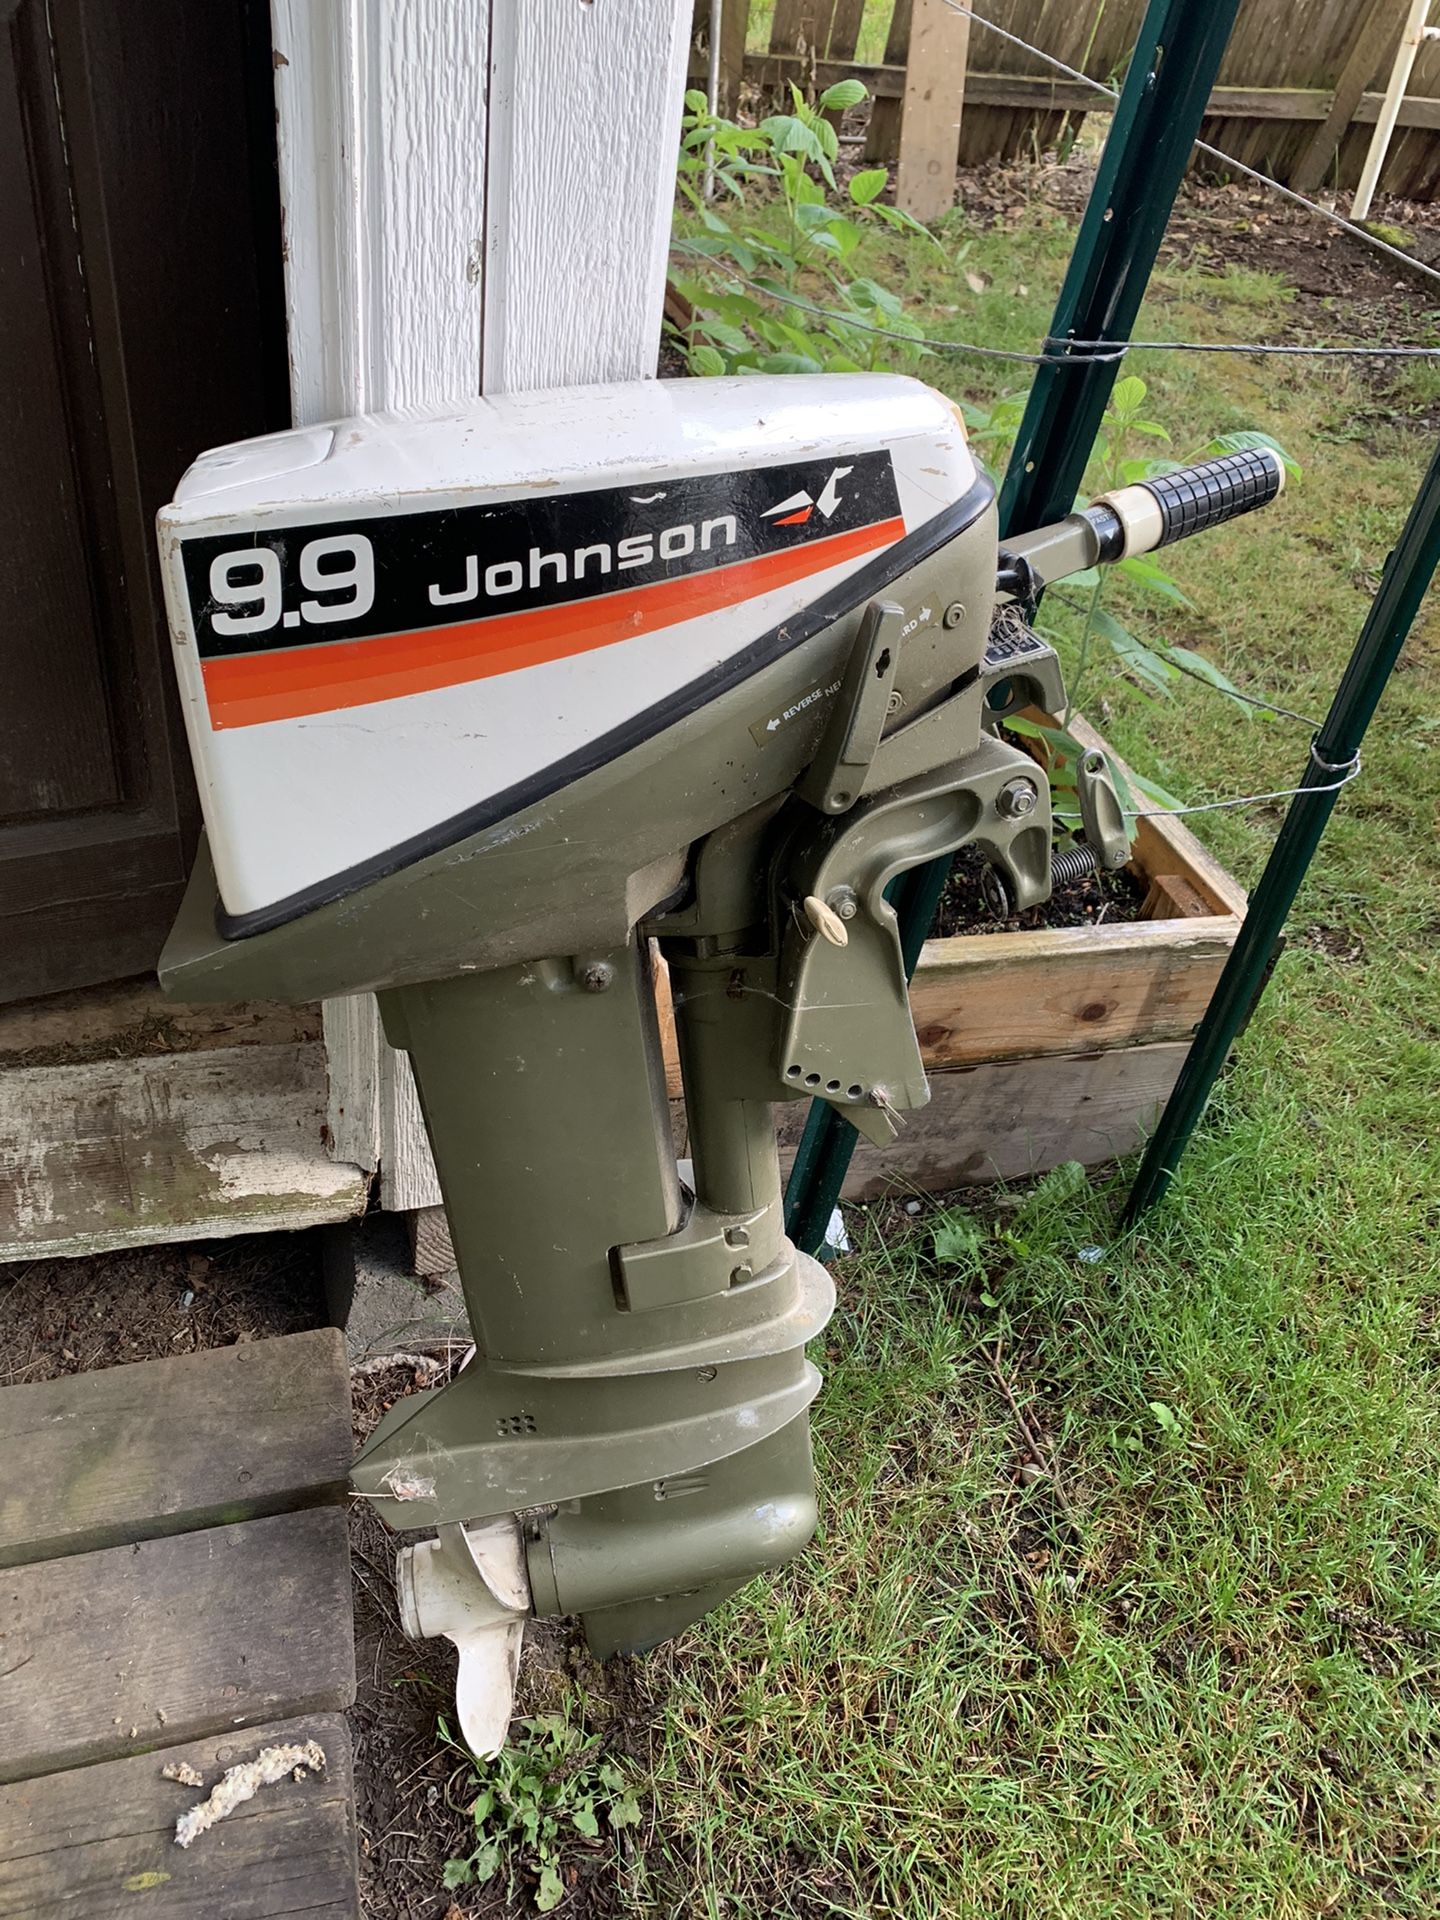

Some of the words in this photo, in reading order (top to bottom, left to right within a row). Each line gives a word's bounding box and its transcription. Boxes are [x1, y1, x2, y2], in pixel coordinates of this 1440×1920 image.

[209, 533, 376, 636] 9.9
[428, 514, 737, 606] Johnson
[782, 687, 824, 721] REVERSE
